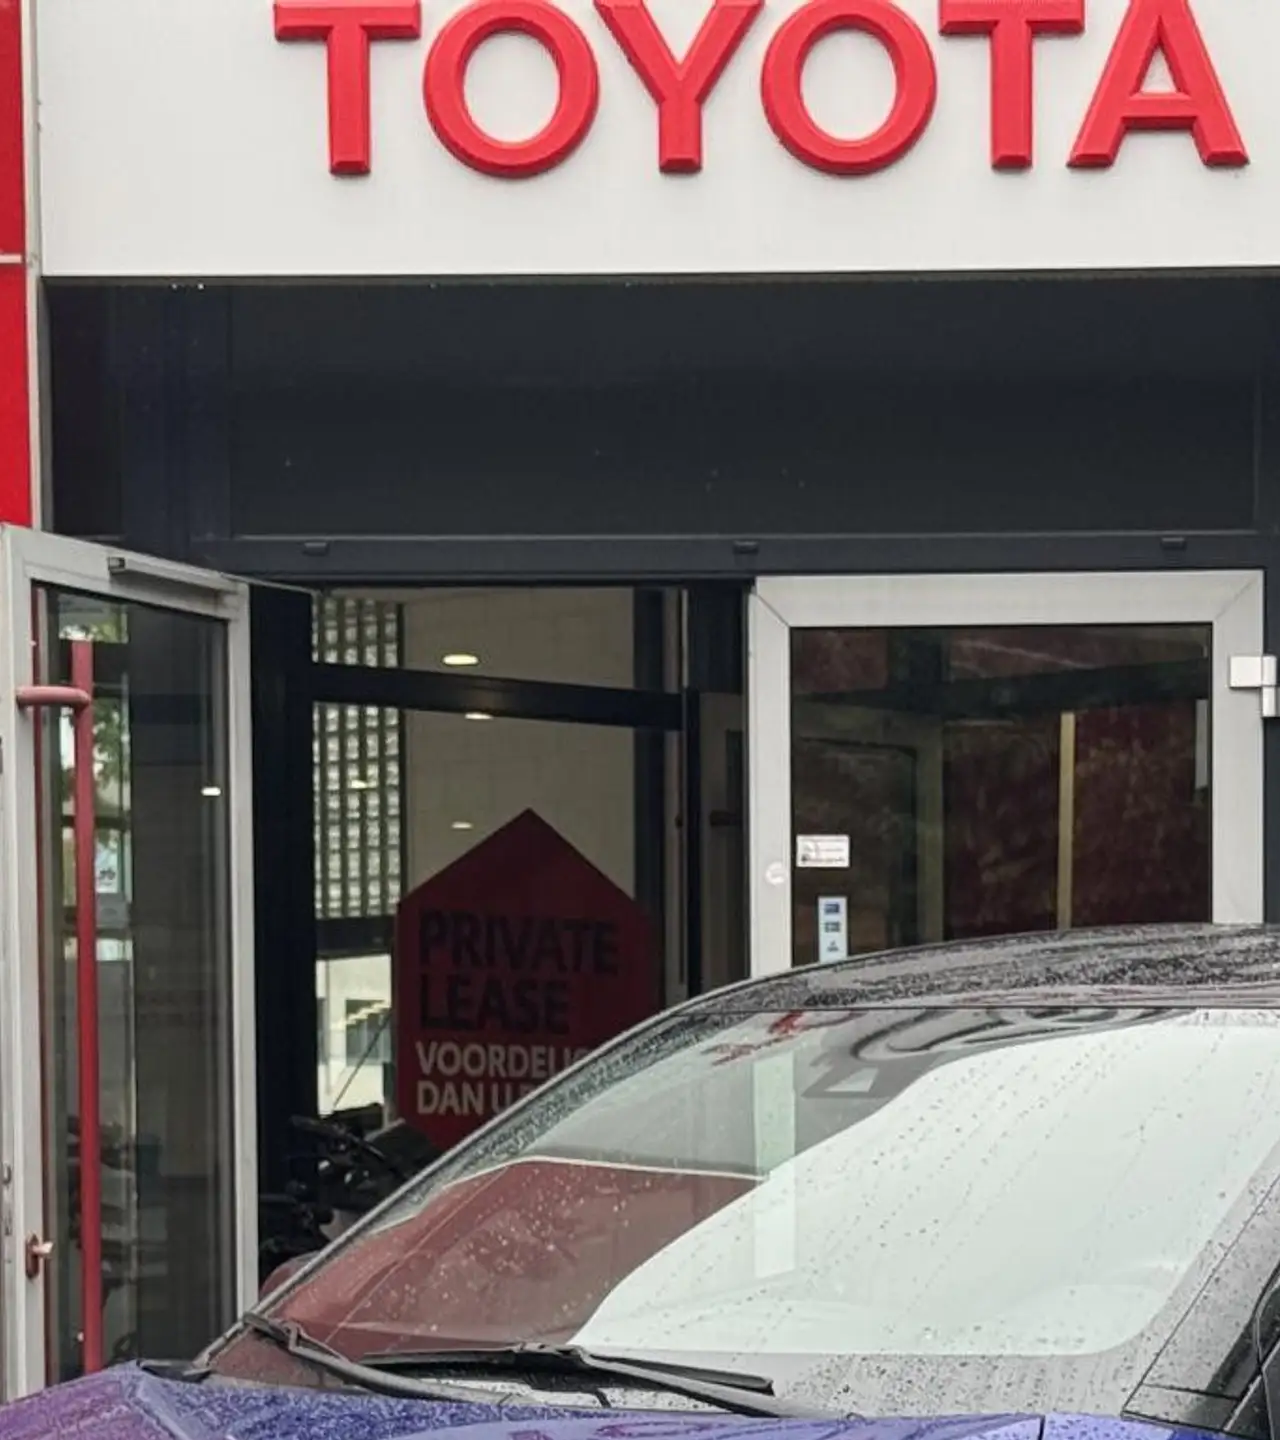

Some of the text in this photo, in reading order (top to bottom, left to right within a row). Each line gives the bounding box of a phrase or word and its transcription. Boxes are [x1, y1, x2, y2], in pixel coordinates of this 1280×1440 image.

[273, 0, 1250, 175] TOYOTA
[419, 909, 619, 976] PRIVATE
[420, 973, 571, 1034] LEASE
[417, 1081, 484, 1117] DAN
